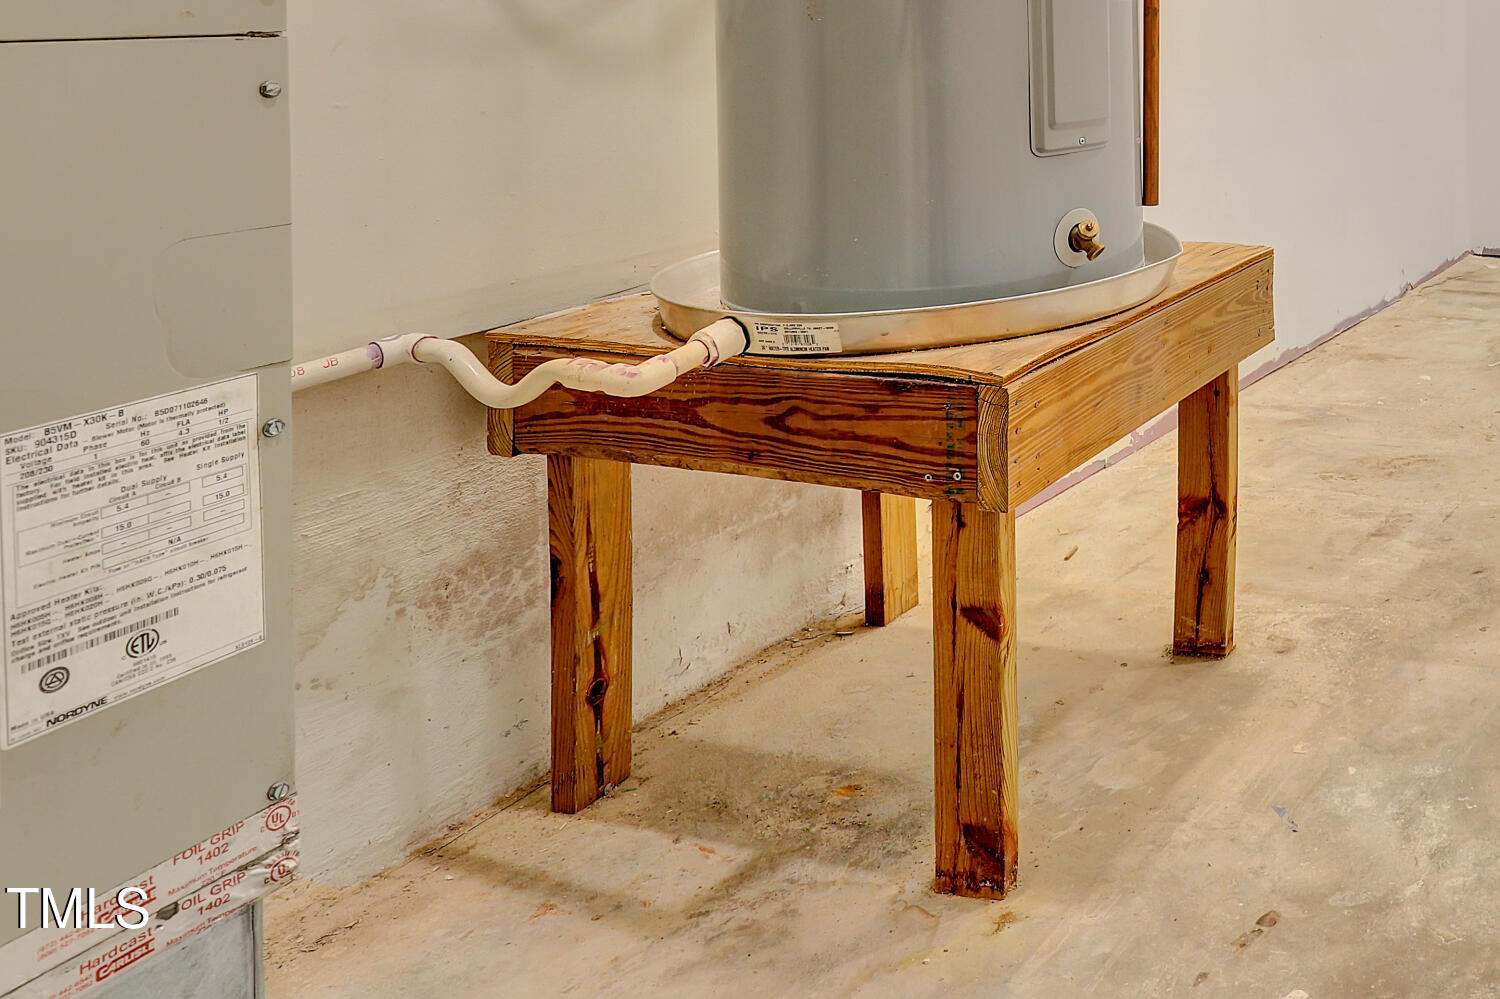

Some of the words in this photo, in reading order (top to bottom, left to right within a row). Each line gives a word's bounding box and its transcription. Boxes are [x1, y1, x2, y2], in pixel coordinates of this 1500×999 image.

[323, 357, 338, 368] JB
[4, 433, 32, 444] Model:
[5, 445, 28, 455] SKU:
[35, 431, 77, 448] 904315D
[20, 457, 52, 469] Voltage
[83, 442, 108, 452] Phase
[177, 419, 190, 427] FLA
[6, 446, 52, 464] Electrical
[56, 441, 78, 451] Data
[196, 459, 218, 471] Single
[221, 452, 244, 463] Supply
[120, 483, 138, 493] Dual
[142, 476, 167, 487] Supply
[216, 473, 227, 481] 5.4
[216, 491, 230, 500] 15.0
[116, 503, 129, 512] 5.4
[115, 522, 132, 531] 15.0
[168, 536, 181, 544] N/A
[10, 602, 51, 621] Approved
[54, 592, 82, 605] Heater
[33, 623, 66, 640] external
[94, 602, 128, 619] pressure
[47, 696, 107, 727] NORDYNE
[172, 844, 206, 866] FOIL
[210, 821, 245, 845] GRIP
[198, 842, 229, 865] 1402
[181, 894, 206, 911] OIL
[210, 872, 246, 895] GRIP
[198, 893, 230, 915] 1402
[80, 928, 152, 974] Hardcast
